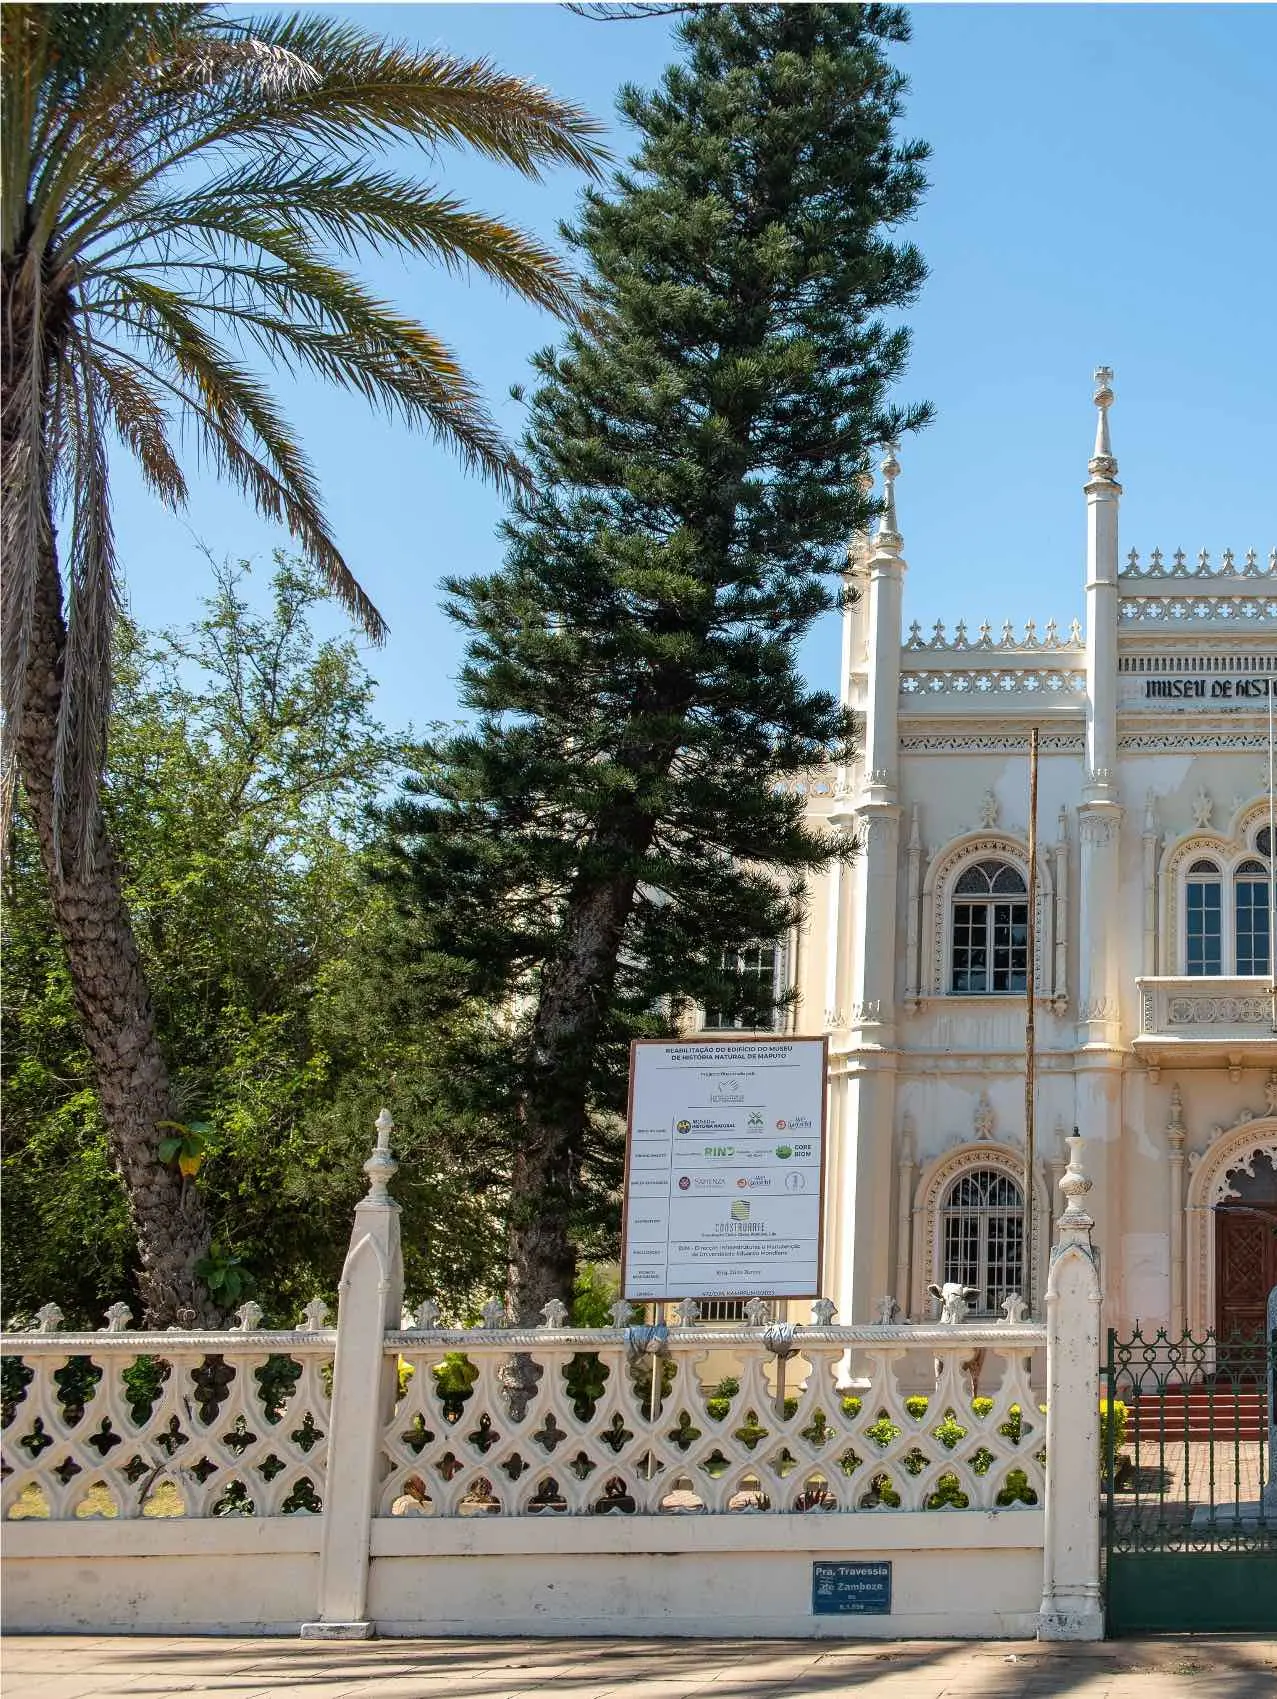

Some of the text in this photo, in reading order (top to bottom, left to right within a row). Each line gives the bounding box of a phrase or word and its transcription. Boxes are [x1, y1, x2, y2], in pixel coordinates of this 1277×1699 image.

[1145, 679, 1206, 698] MUSEU
[1211, 679, 1232, 697] DE
[839, 1567, 888, 1576] Travessia
